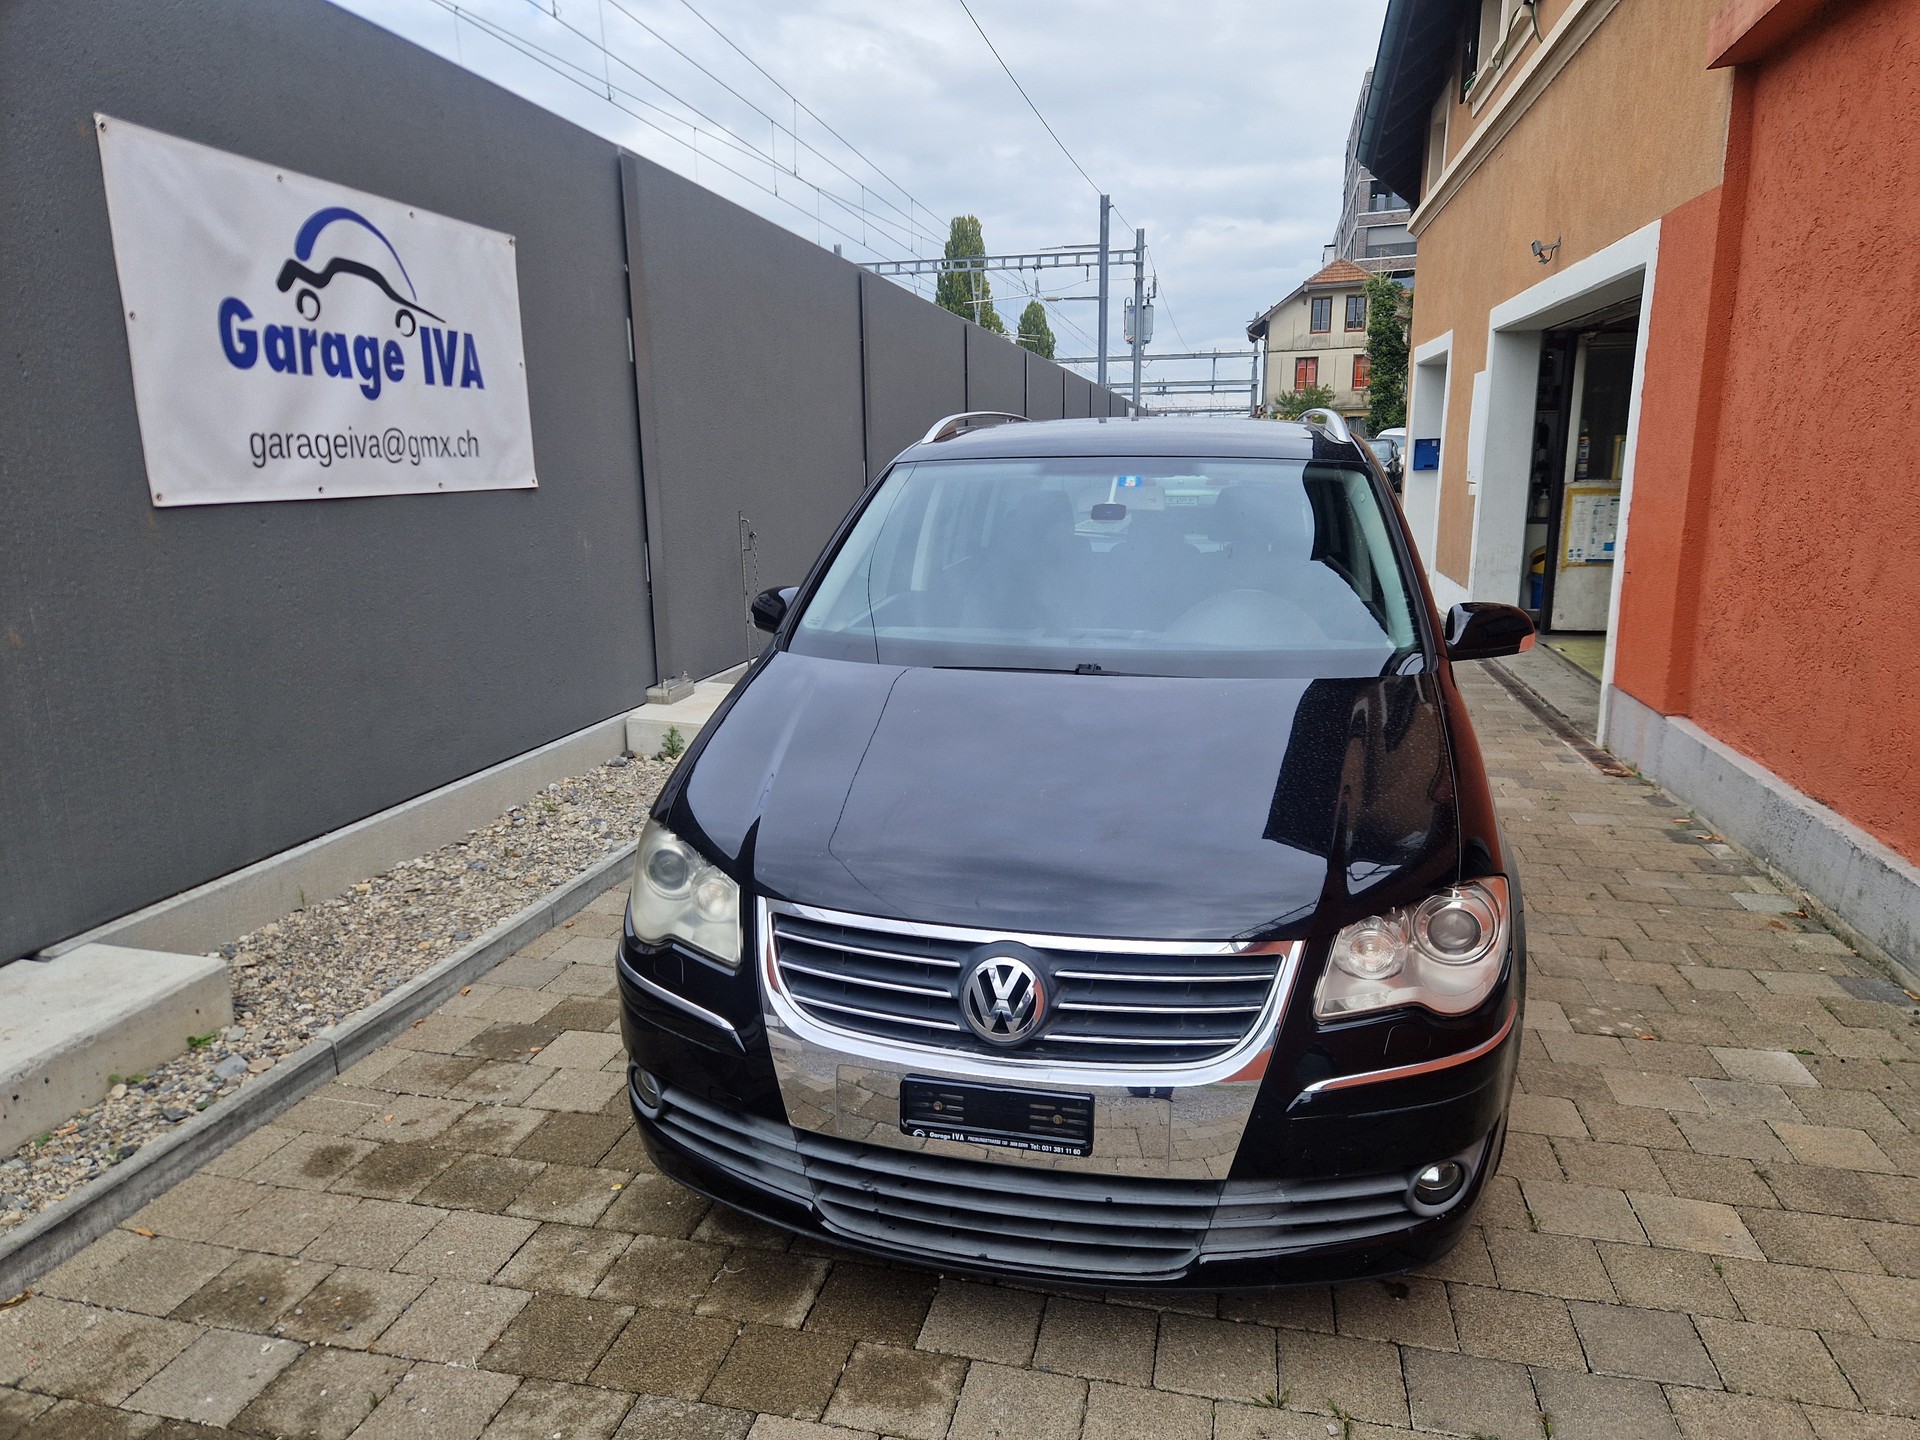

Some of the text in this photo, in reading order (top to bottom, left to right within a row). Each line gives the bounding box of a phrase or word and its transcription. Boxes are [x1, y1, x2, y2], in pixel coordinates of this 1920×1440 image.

[217, 296, 485, 401] Garage IVA
[249, 426, 480, 468] garageiva@gmx.ch
[929, 1132, 951, 1140] Garage
[952, 1133, 965, 1141] IVA
